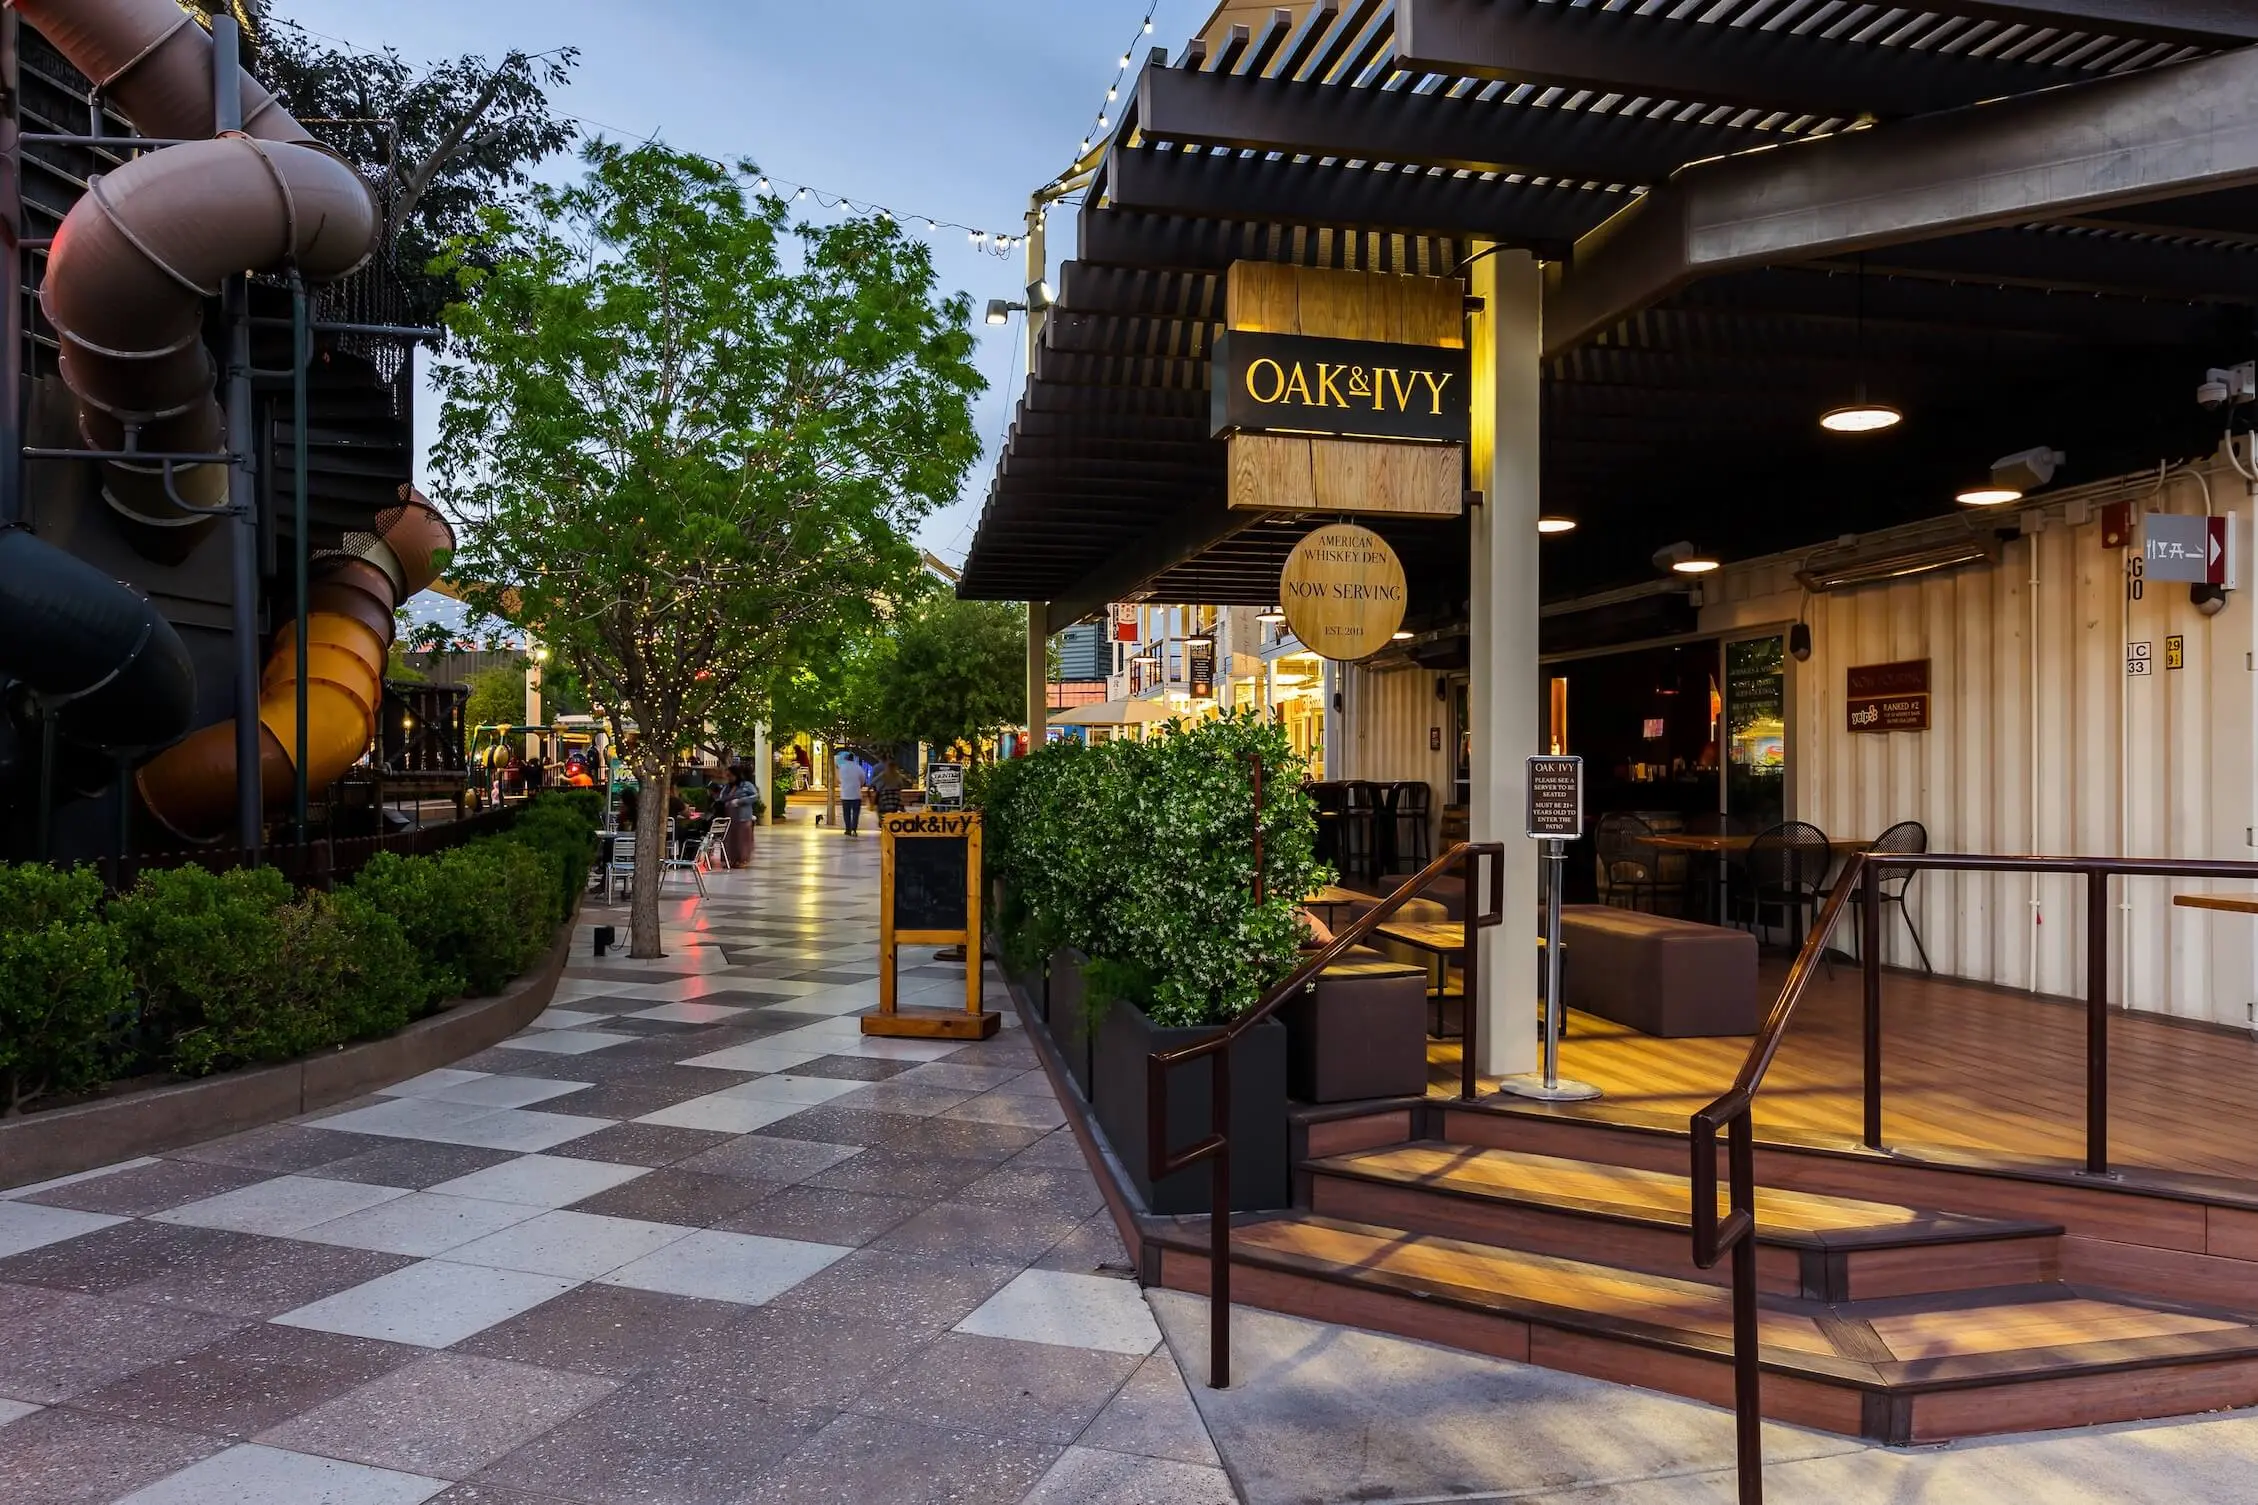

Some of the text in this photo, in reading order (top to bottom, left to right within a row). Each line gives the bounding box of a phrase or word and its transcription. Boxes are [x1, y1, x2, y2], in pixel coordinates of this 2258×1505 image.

[1246, 358, 1453, 415] OAK&IVY
[1318, 535, 1373, 548] AMERICAN
[1304, 549, 1387, 563] WHISKEY DEN
[1288, 581, 1401, 601] NOW SERVING
[2136, 645, 2147, 657] C
[1559, 763, 1575, 772] IVY
